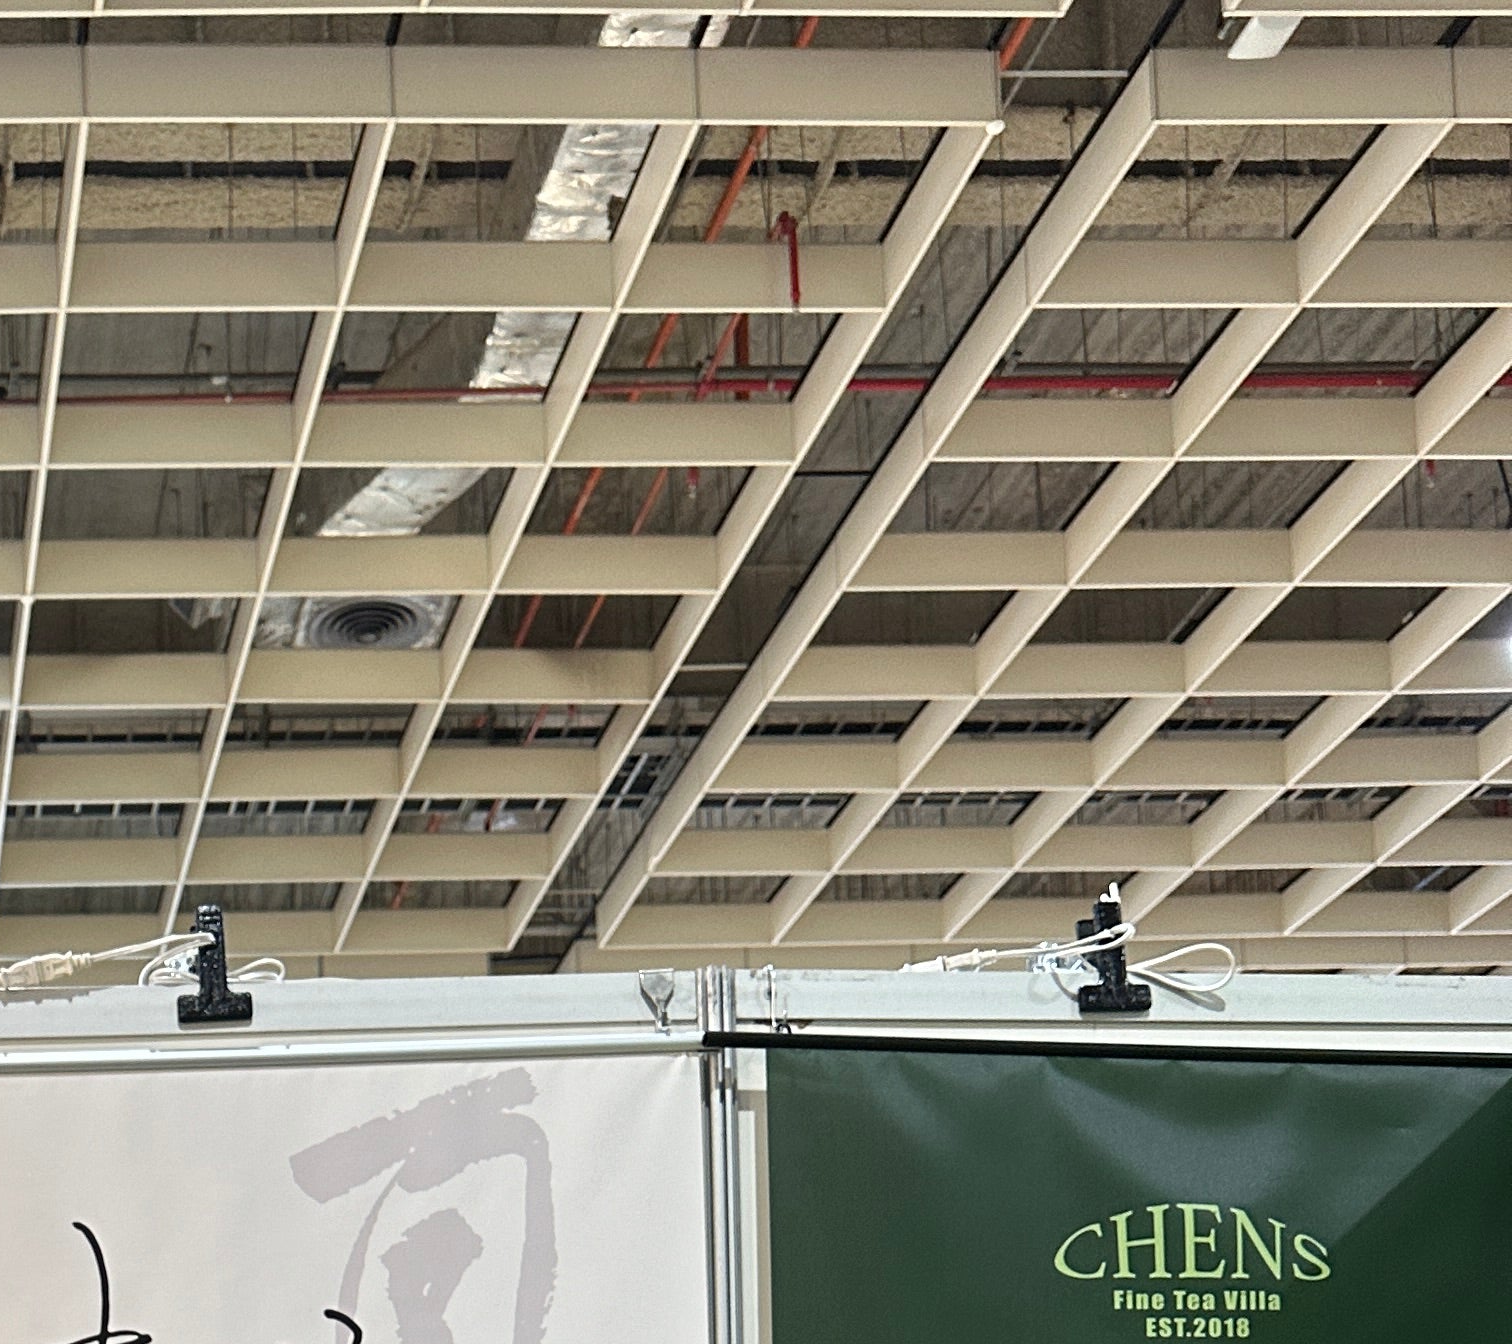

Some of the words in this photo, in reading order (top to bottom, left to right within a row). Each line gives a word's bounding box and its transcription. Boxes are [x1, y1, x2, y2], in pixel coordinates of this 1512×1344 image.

[1113, 1290, 1167, 1311] Fine
[1173, 1290, 1216, 1311] Tea
[1223, 1290, 1281, 1312] Villa
[1145, 1317, 1251, 1339] EST.2018
